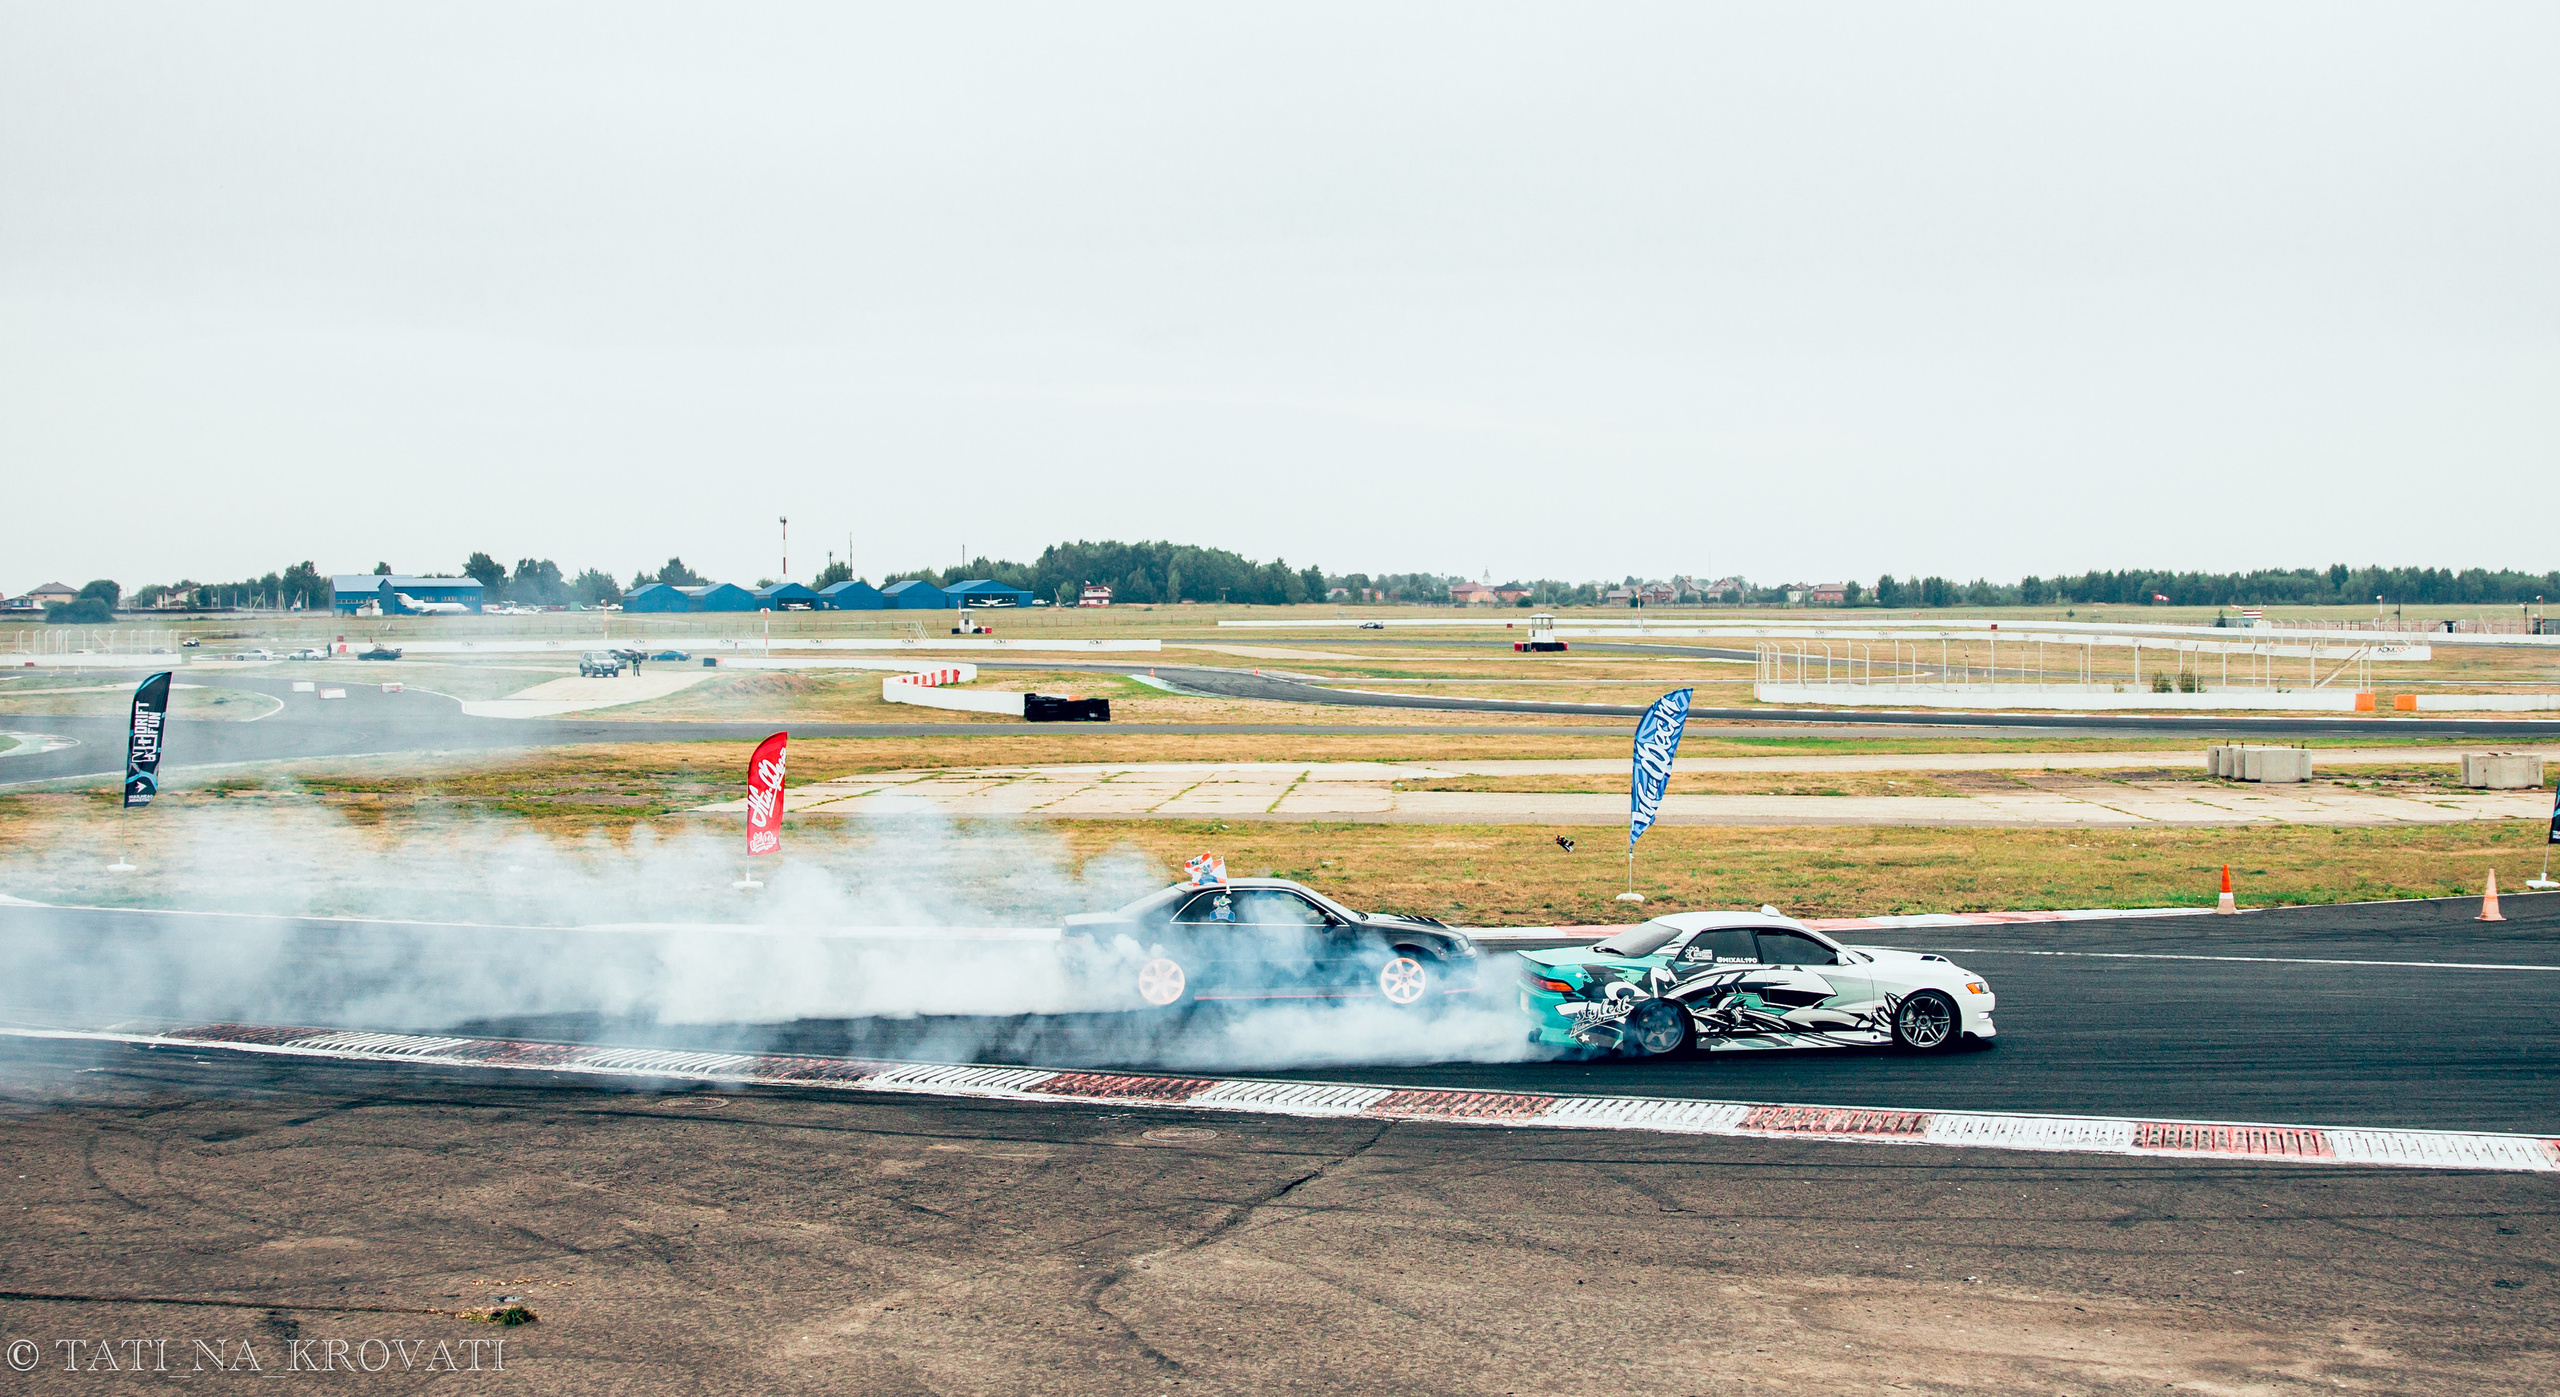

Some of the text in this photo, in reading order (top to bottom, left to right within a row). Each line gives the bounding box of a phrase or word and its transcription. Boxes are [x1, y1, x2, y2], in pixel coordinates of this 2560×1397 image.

[134, 701, 150, 734] DRIFT
[147, 711, 161, 734] FUN
[1716, 956, 1758, 964] @MIXAL190
